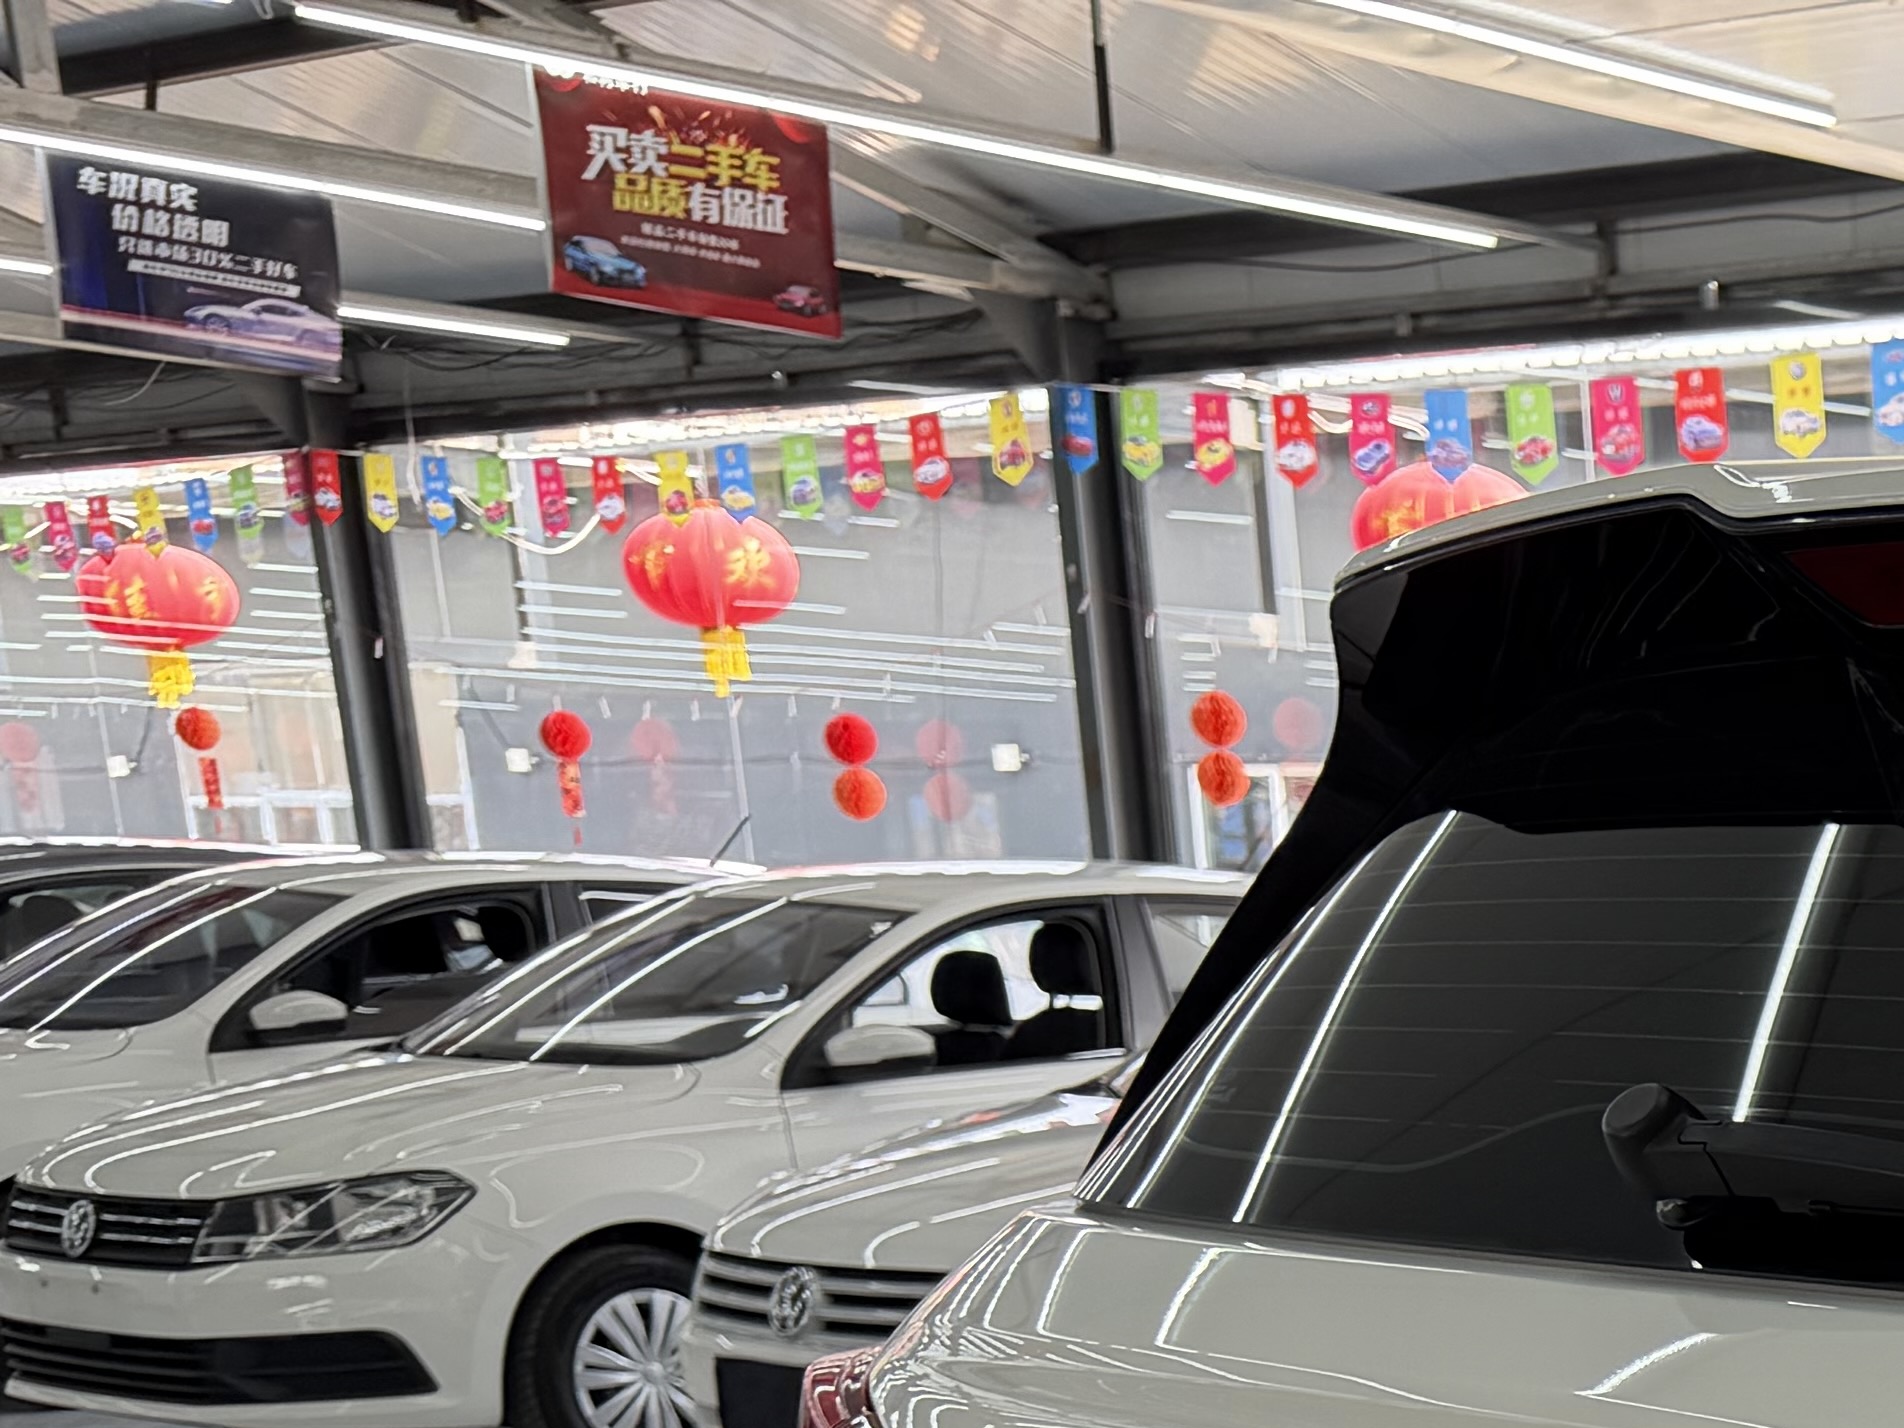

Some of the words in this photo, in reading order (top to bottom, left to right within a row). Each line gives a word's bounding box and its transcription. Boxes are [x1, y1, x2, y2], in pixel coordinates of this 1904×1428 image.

[581, 124, 781, 191] 买卖二手车
[77, 165, 199, 213] 车况真实
[612, 172, 789, 235] 品质有保证
[111, 202, 231, 248] 价格透明
